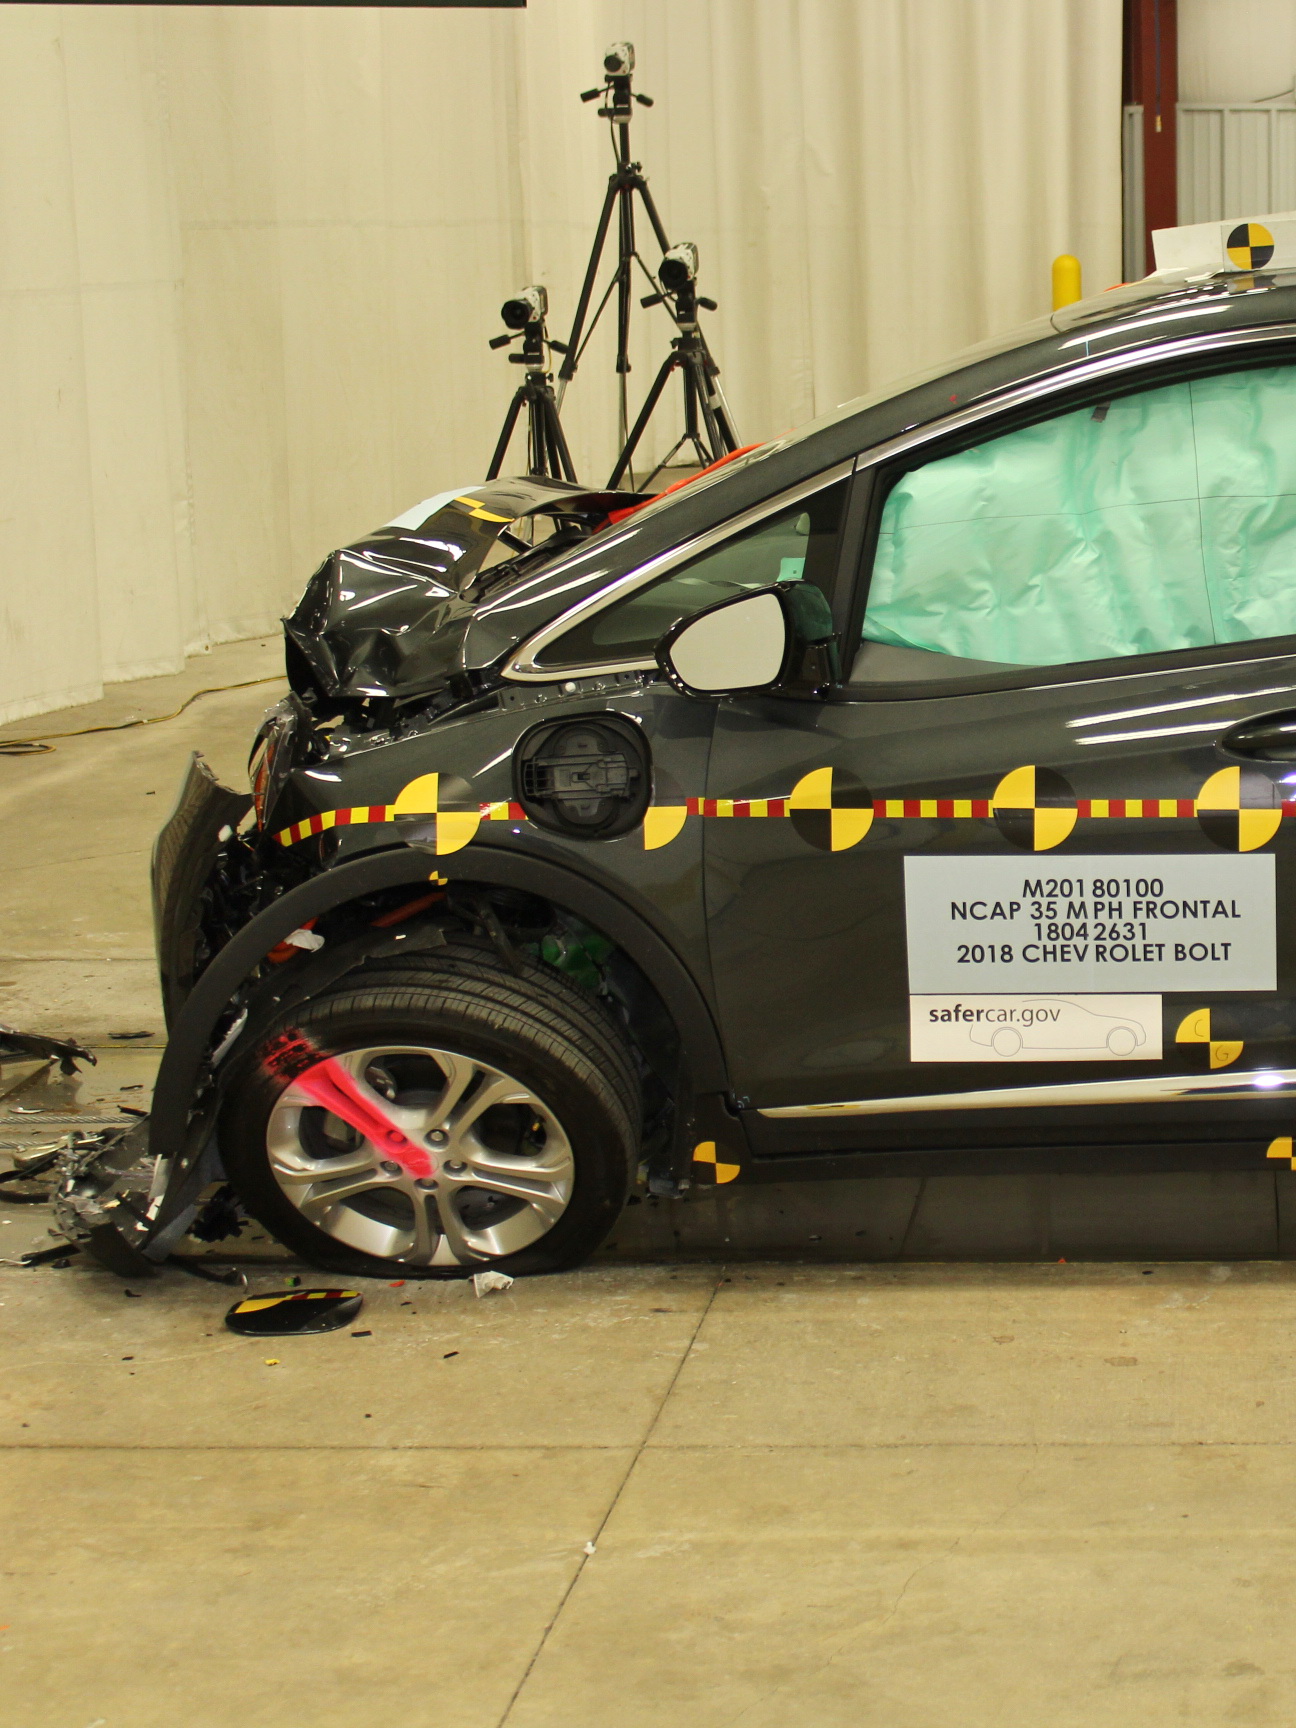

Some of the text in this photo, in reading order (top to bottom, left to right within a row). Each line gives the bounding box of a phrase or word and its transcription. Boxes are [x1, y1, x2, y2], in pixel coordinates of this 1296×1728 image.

[950, 899, 1242, 921] NCAP 35 MPH FRONTAL
[956, 942, 1232, 964] 2018 CHEVROLET BOLT
[928, 1003, 1061, 1028] safercar.gov
